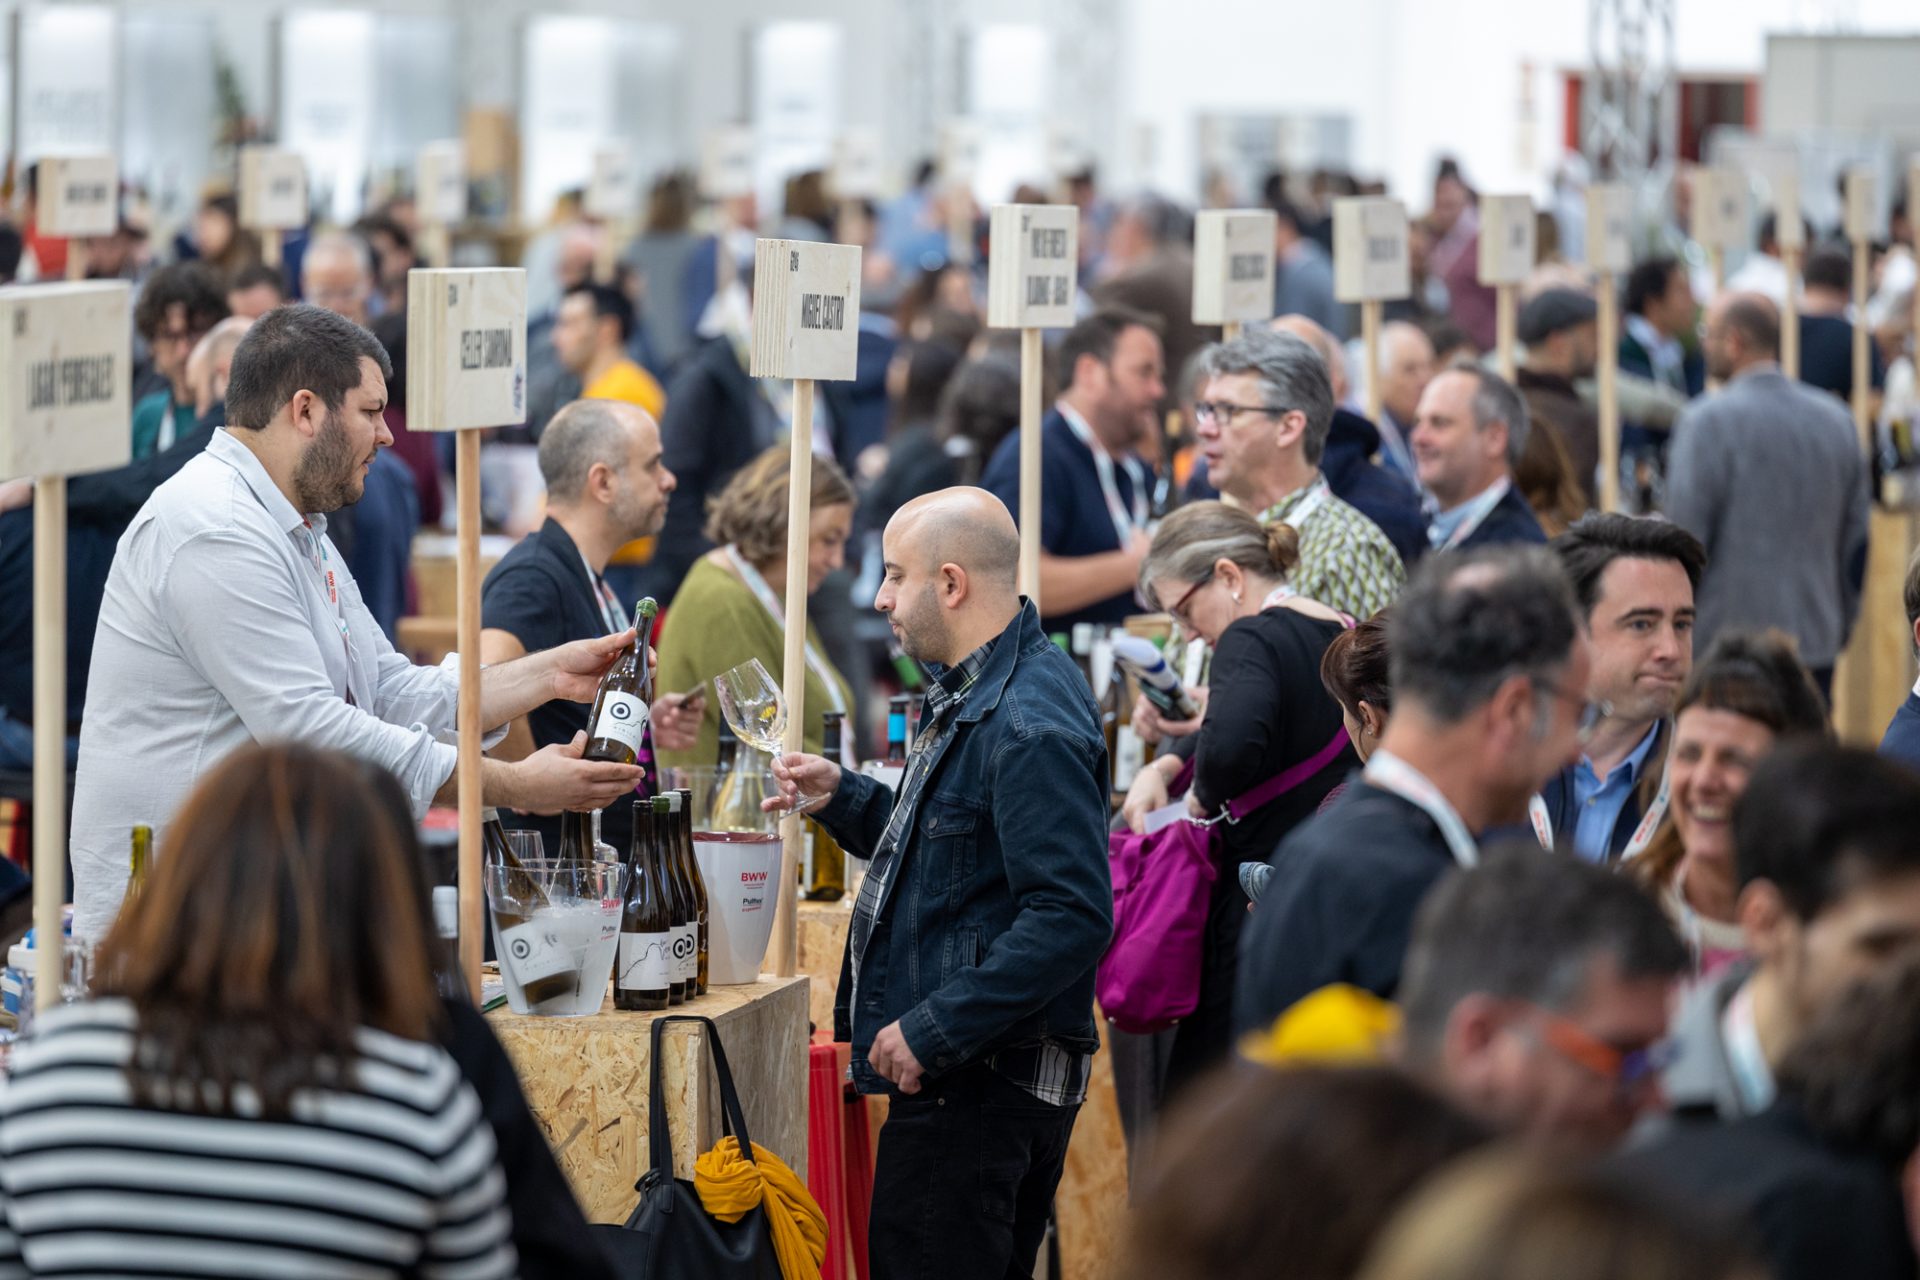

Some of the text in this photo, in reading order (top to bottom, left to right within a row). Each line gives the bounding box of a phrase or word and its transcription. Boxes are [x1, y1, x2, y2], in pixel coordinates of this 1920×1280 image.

[801, 293, 844, 331] MIGUEL CASTRO
[461, 330, 482, 370] CELLER
[741, 871, 768, 882] BWW
